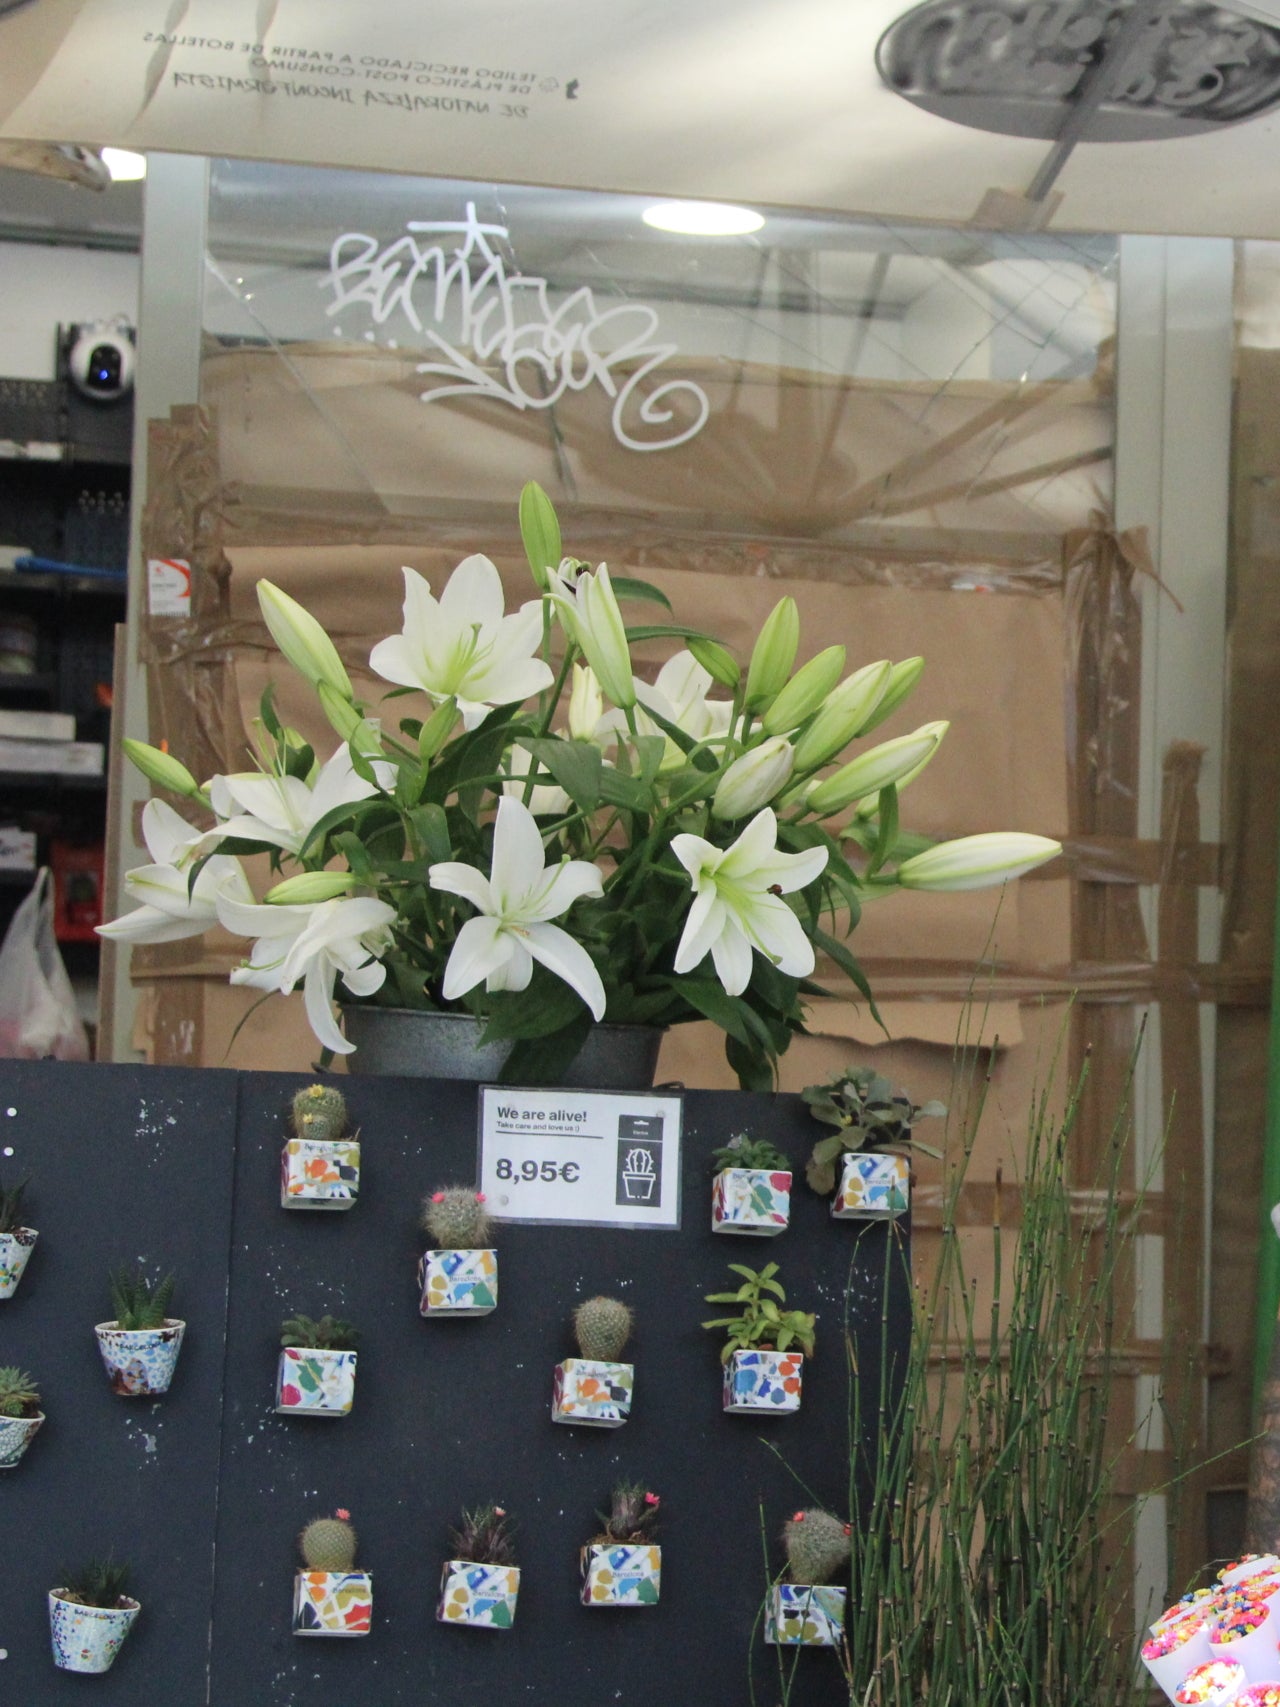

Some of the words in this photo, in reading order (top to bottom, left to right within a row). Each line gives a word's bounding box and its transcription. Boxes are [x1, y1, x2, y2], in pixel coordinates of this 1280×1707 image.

[497, 1106, 519, 1119] We
[522, 1109, 546, 1121] are
[549, 1110, 588, 1122] alive!
[496, 1120, 514, 1130] Take
[515, 1123, 531, 1131] care
[532, 1122, 547, 1131] and
[548, 1123, 564, 1132] love
[496, 1157, 580, 1185] 8,95€
